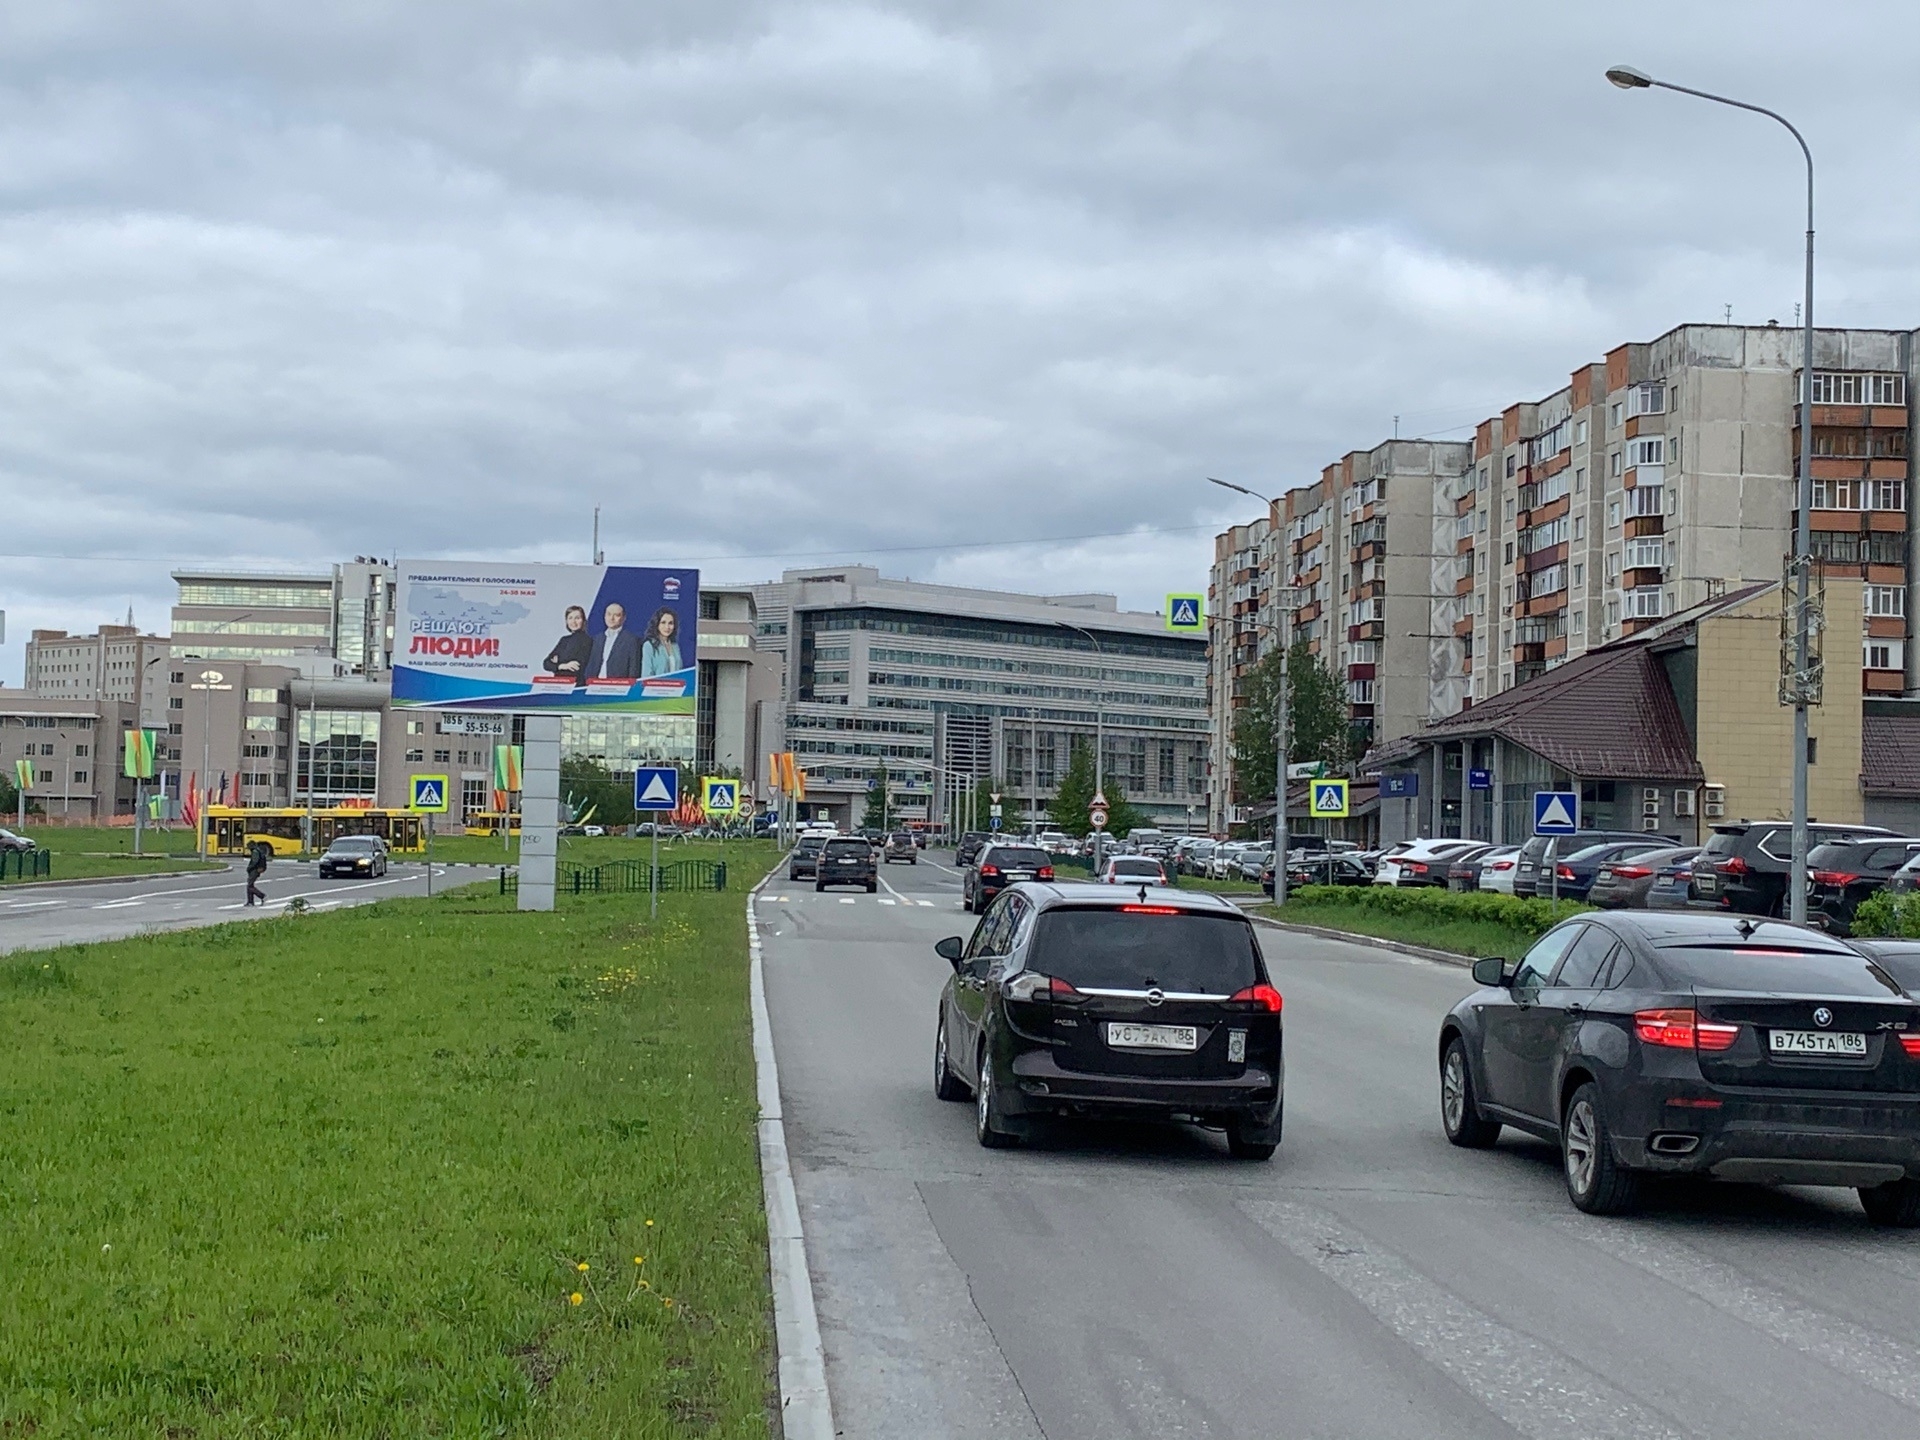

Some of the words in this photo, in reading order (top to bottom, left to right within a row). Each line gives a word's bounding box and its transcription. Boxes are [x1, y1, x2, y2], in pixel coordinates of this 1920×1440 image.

[408, 575, 481, 583] ПРЕДВАРИТЕЛЬНОЕ
[411, 620, 485, 635] РЕШАЮТ
[409, 636, 500, 659] ЛЮДИ!
[466, 722, 502, 733] 55-55-66
[1775, 1032, 1836, 1050] В745ТА
[1839, 1034, 1862, 1047] 186
